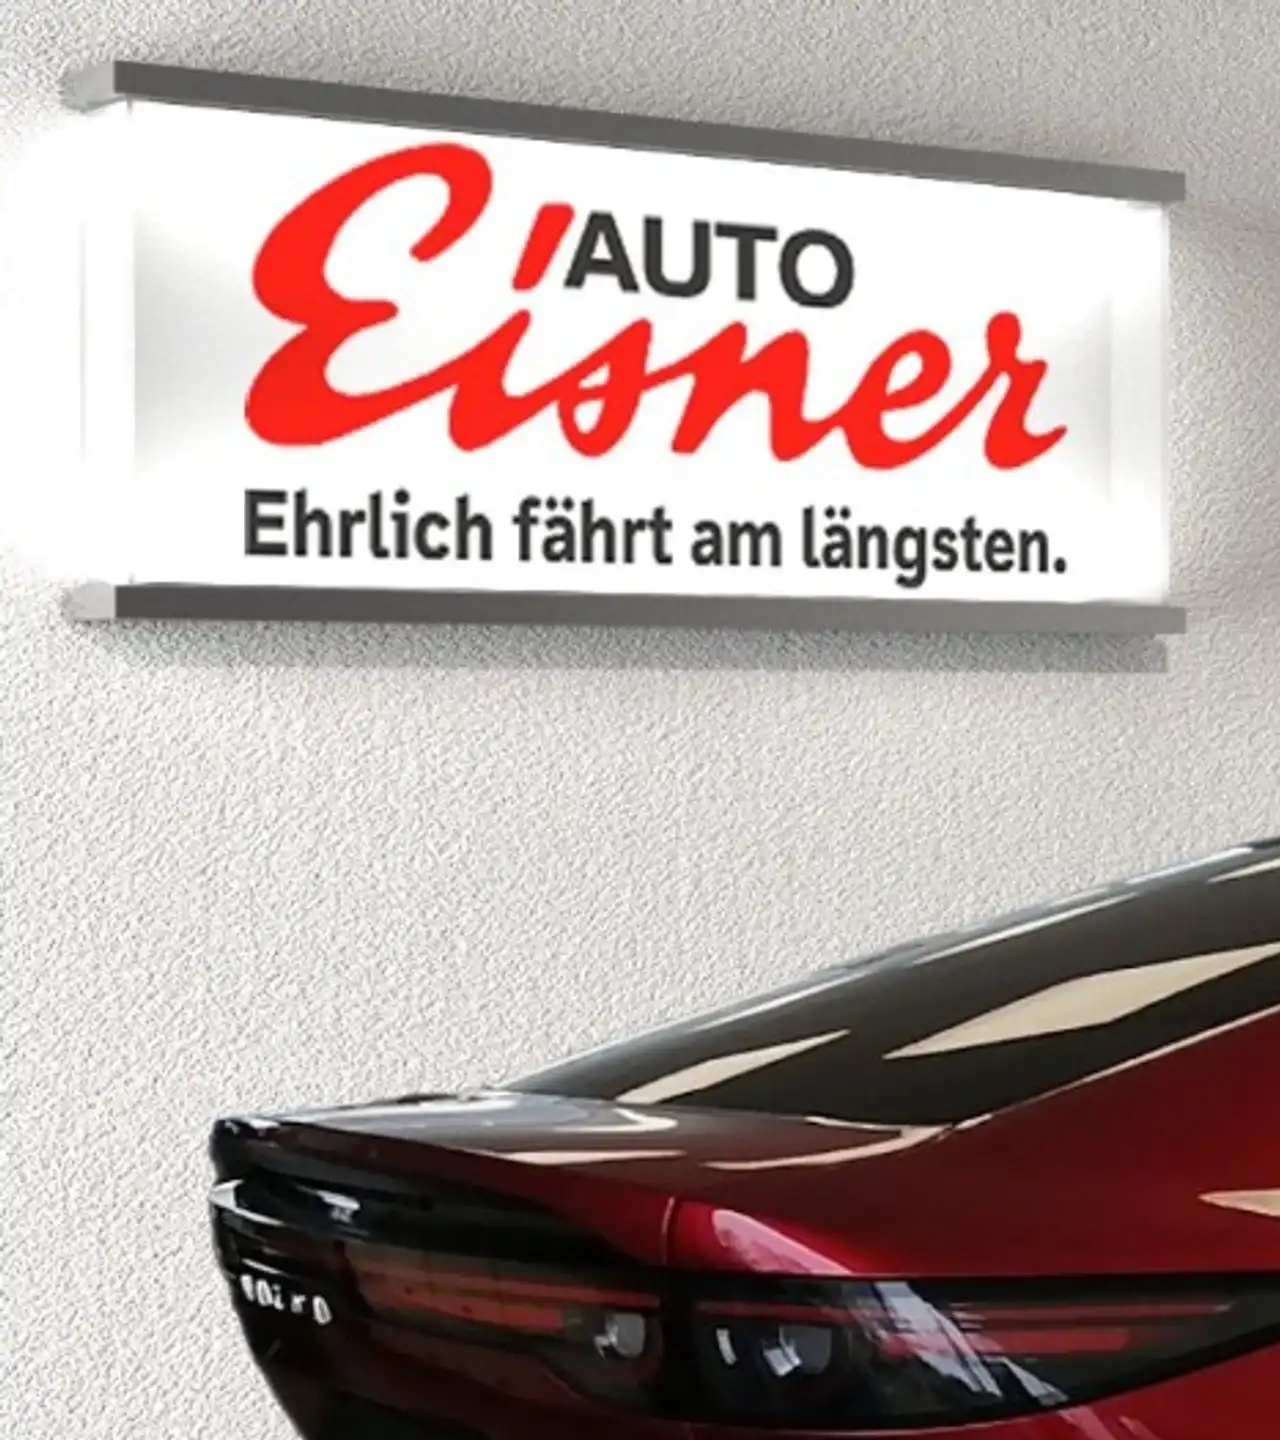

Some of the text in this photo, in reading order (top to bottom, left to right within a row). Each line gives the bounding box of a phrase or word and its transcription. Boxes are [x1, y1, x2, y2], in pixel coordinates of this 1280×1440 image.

[243, 141, 1067, 472] Eisner
[564, 210, 854, 309] AUTO
[244, 489, 1067, 589] Ehrlich fährt am längsten.
